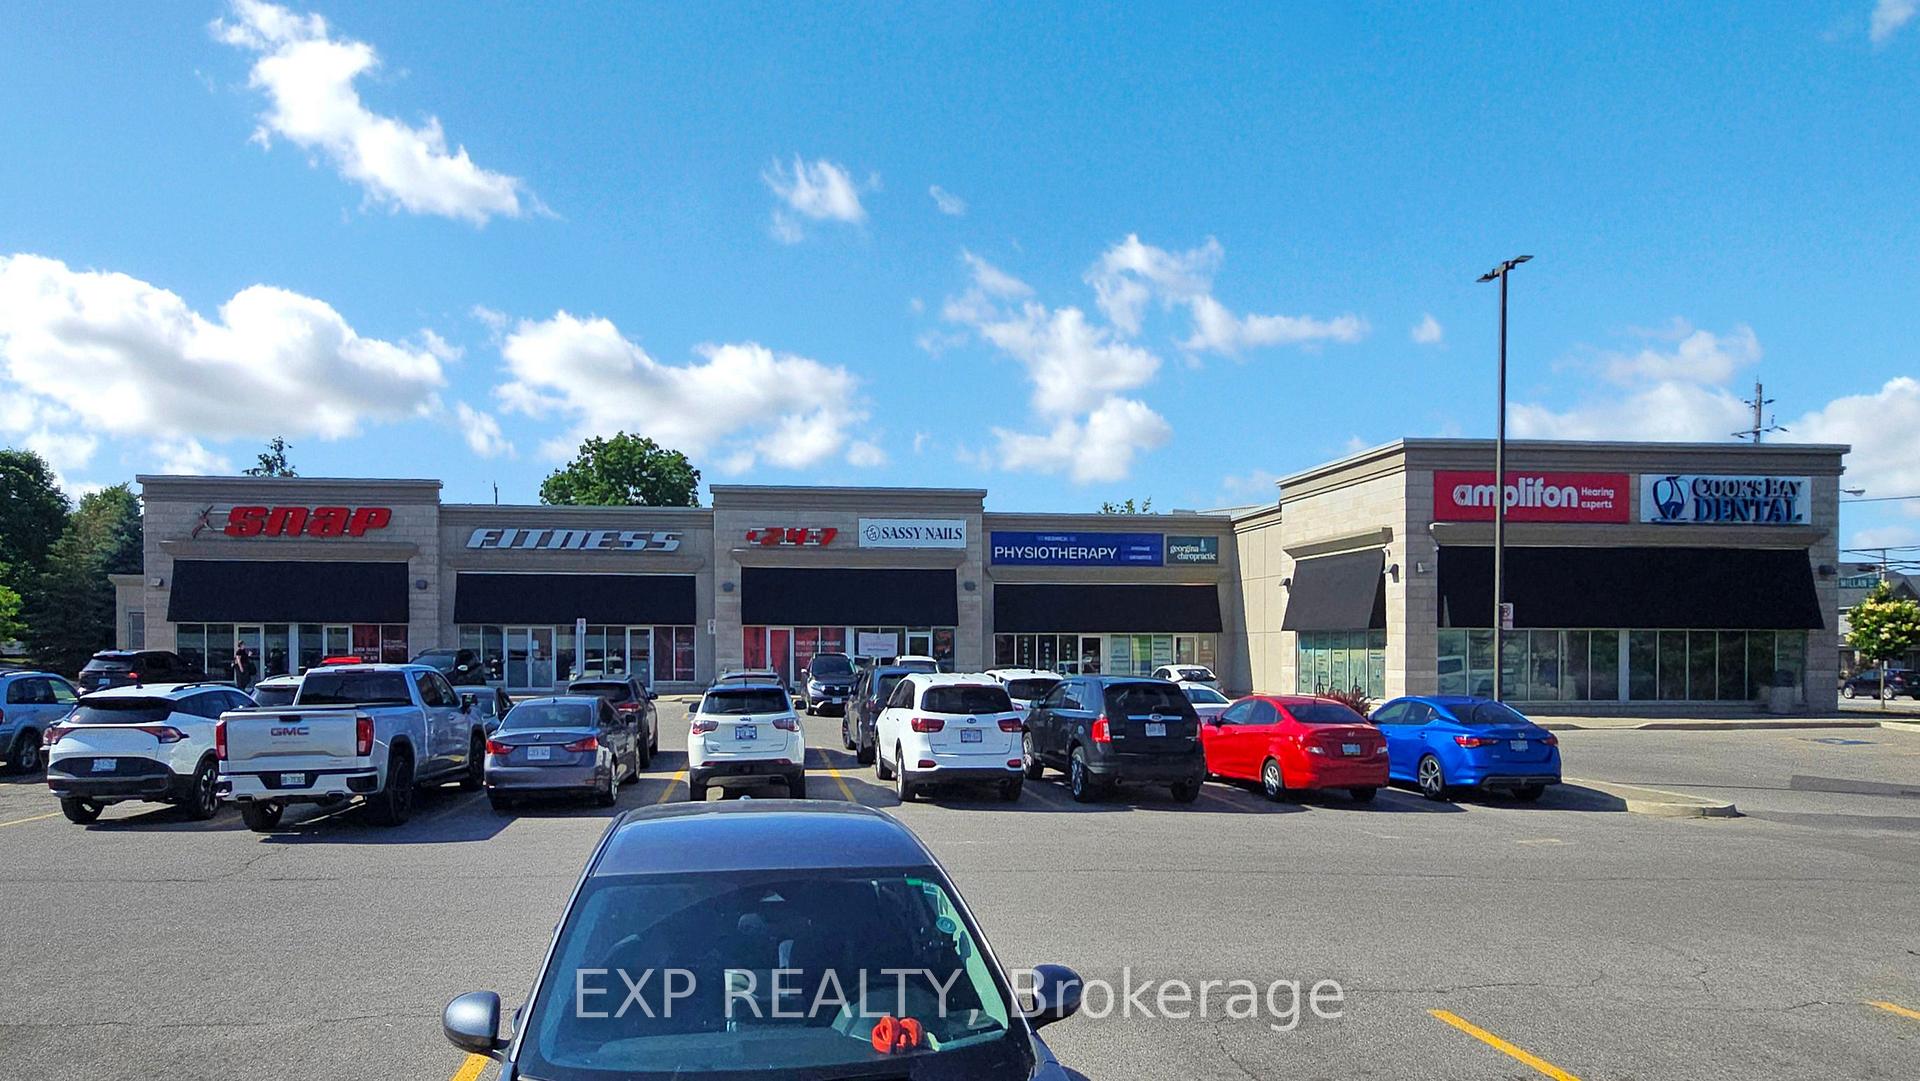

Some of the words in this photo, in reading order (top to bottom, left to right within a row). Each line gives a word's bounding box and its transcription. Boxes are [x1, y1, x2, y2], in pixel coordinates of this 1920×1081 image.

[1452, 477, 1578, 515] amplifon
[1581, 486, 1614, 499] Hearing
[1581, 500, 1613, 511] experts
[1694, 498, 1803, 523] DENTAL
[881, 526, 922, 540] SASSY
[925, 527, 963, 540] NAILS
[994, 546, 1117, 559] PHYSIOTHERAPY
[1170, 544, 1199, 554] georgina
[1177, 552, 1216, 562] chiropractic
[270, 727, 310, 736] GMC
